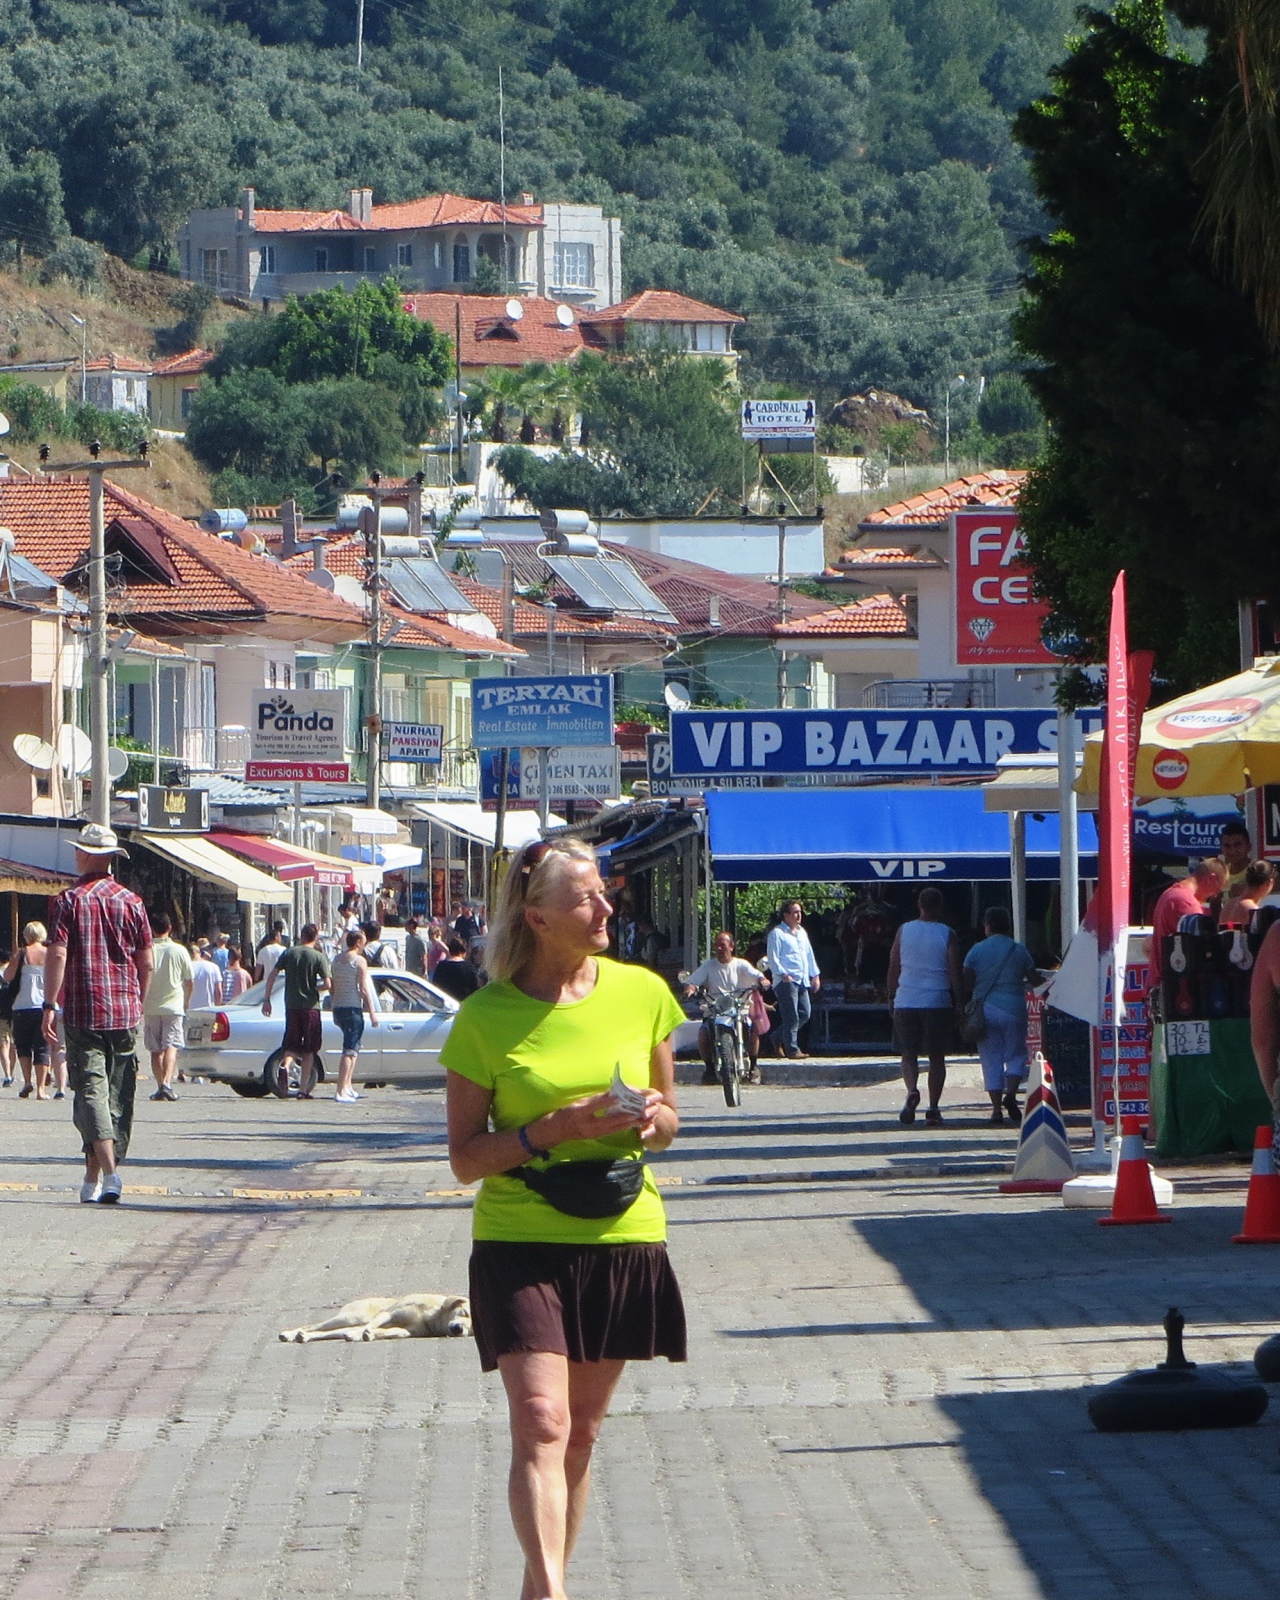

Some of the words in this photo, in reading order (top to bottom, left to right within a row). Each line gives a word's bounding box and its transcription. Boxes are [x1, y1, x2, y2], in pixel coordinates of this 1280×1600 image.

[757, 415, 802, 423] HOTEL
[972, 576, 1029, 605] CE
[477, 678, 604, 711] TERYAKİ
[258, 702, 334, 731] Panda
[507, 704, 571, 716] EMLAK
[394, 726, 439, 737] NURHAL
[478, 721, 501, 733] Real
[505, 720, 538, 732] Estate
[256, 733, 284, 742] Tourism
[292, 733, 313, 742] Travel
[314, 734, 338, 744] Agency
[689, 721, 783, 767] VIP
[804, 718, 1016, 766] BAZAAR
[399, 747, 430, 757] APART
[249, 766, 304, 778] Excursions
[307, 767, 314, 778] &
[319, 767, 346, 779] Tours
[578, 765, 613, 778] TAXI
[1189, 837, 1213, 845] CAFE
[868, 860, 947, 878] VIP
[1191, 1022, 1209, 1033] TL
